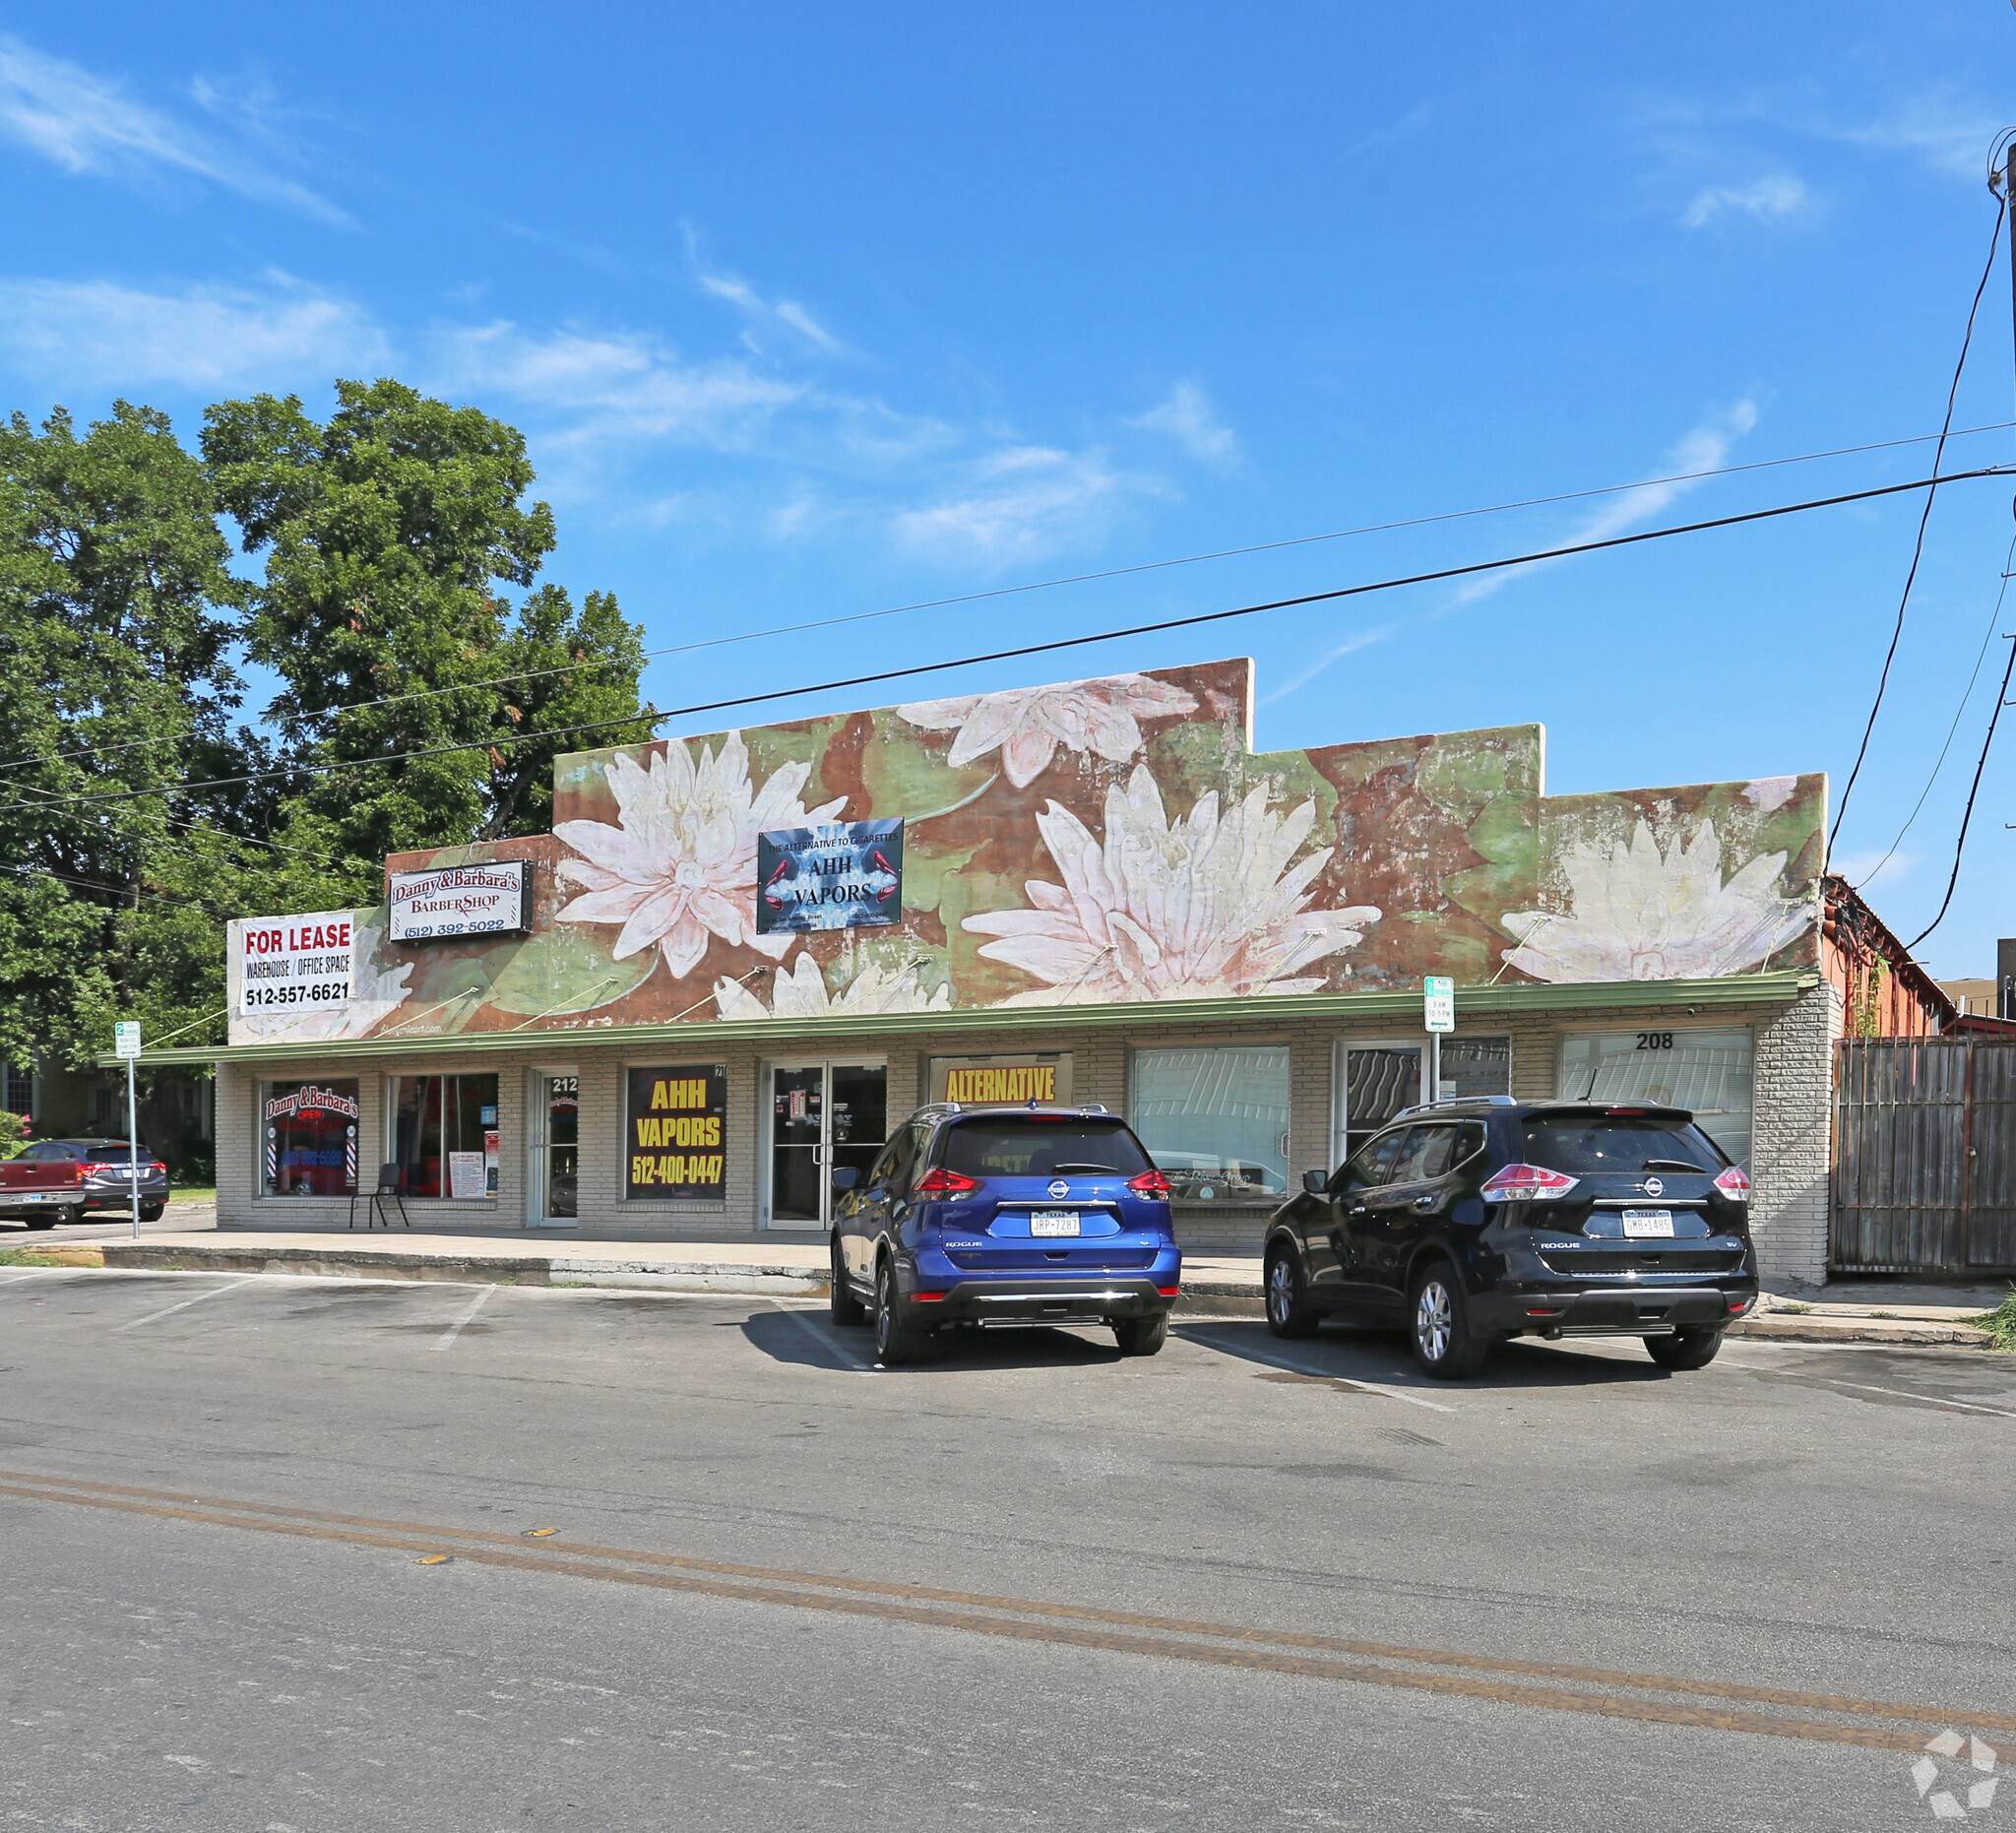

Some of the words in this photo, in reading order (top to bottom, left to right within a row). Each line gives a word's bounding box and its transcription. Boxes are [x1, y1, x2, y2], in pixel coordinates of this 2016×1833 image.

[769, 844, 784, 853] THE
[784, 839, 836, 852] ALTERNATIVE
[838, 837, 849, 847] TO
[850, 833, 899, 846] CIGARETTES
[808, 855, 852, 877] AHH
[394, 875, 440, 904] Danny
[439, 869, 453, 890] &
[453, 868, 520, 892] Barbara's
[794, 883, 872, 907] VAPORS
[245, 929, 283, 955] FOR
[289, 923, 350, 952] LEASE
[405, 925, 433, 939] (512)
[437, 918, 505, 935] 392-5022
[246, 960, 290, 980] WAREHOUSE
[297, 957, 324, 976] OFFICE
[325, 955, 350, 974] SPACE
[1426, 980, 1433, 994] 2
[117, 1025, 123, 1034] 2
[1636, 1033, 1673, 1050] 208
[552, 1078, 578, 1092] 212
[651, 1078, 707, 1109] AHH
[946, 1066, 1055, 1103] ALTERNATIVE
[266, 1093, 299, 1120] Danny
[299, 1086, 310, 1108] &
[309, 1086, 358, 1119] Barbara's
[297, 1109, 323, 1120] OPEN
[636, 1116, 722, 1148] VAPORS
[632, 1154, 724, 1185] 512-400-0447
[1219, 1170, 1251, 1188] Group
